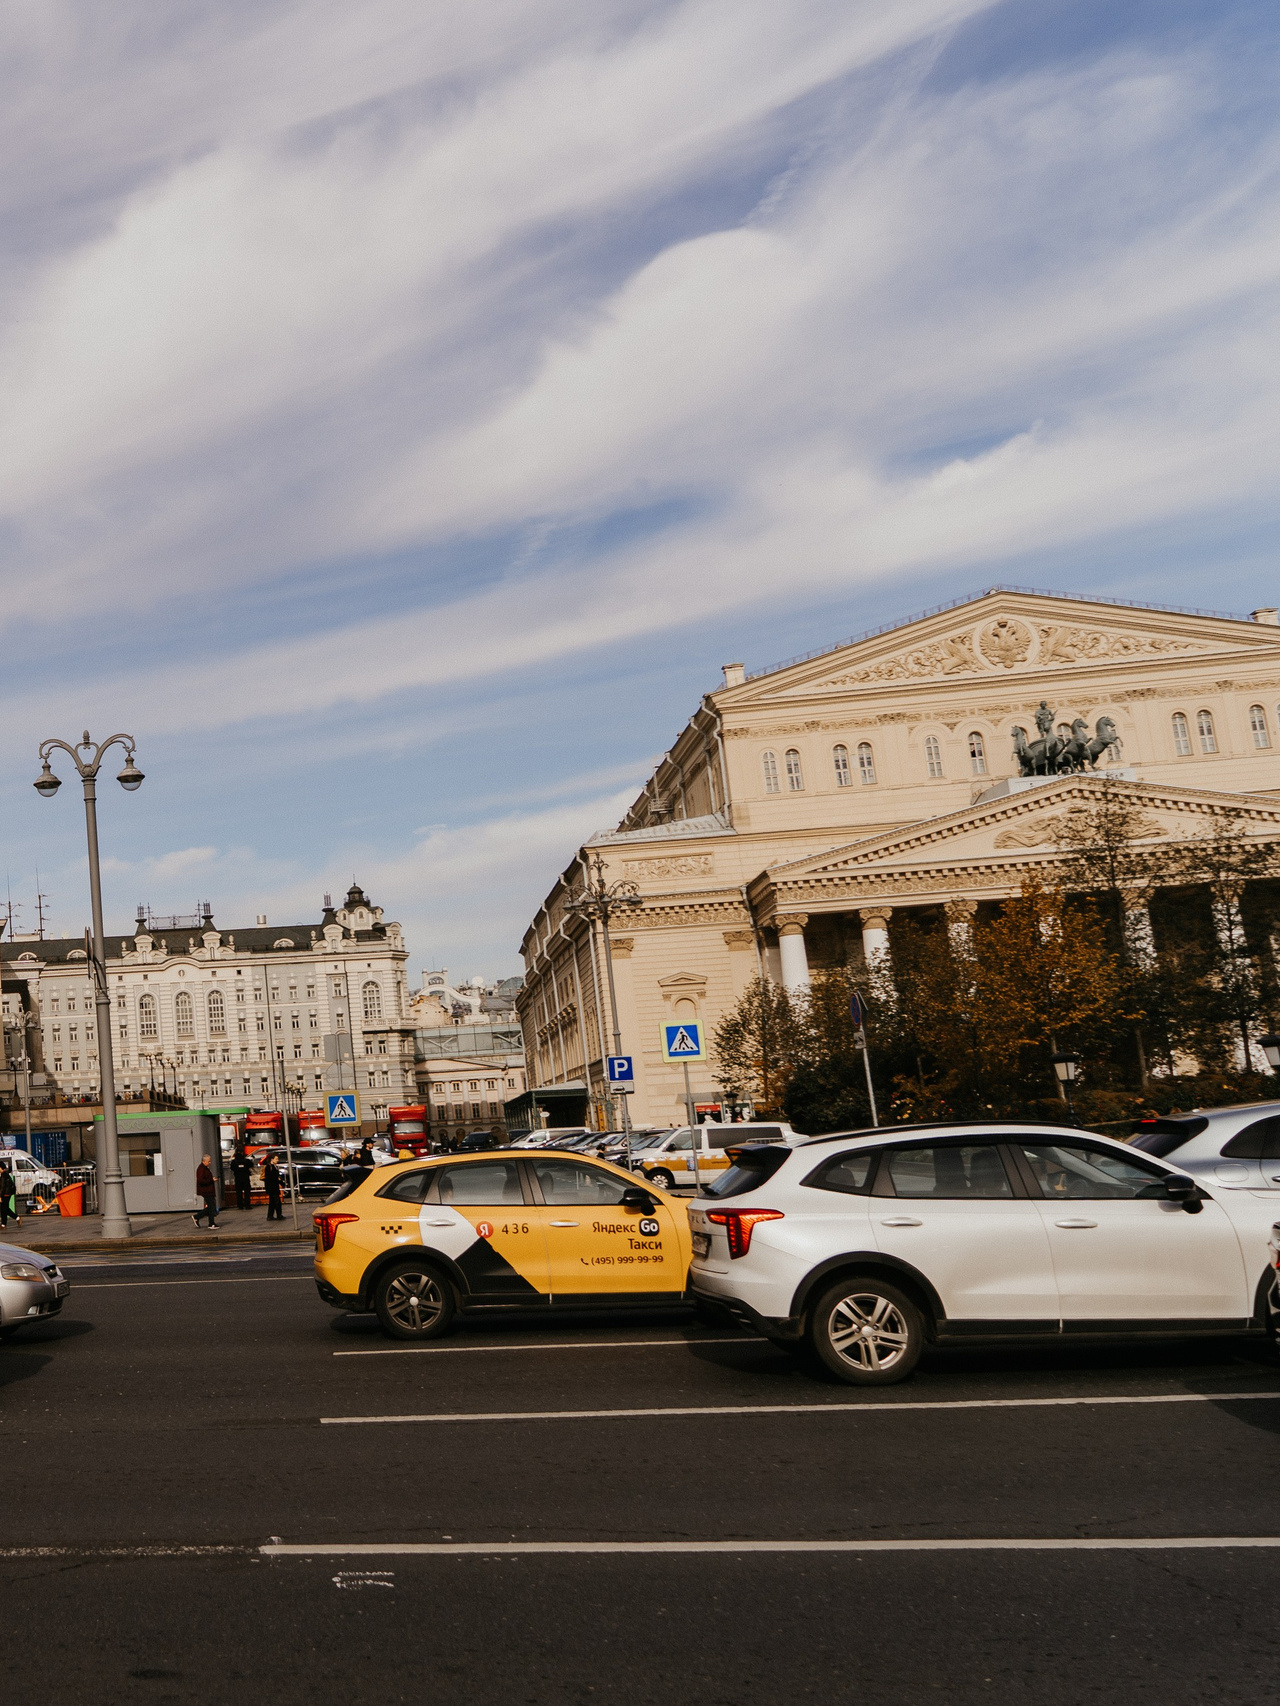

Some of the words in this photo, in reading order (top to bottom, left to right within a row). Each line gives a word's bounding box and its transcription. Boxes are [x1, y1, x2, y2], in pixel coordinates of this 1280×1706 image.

[613, 1059, 628, 1078] P
[479, 1224, 489, 1236] Я
[501, 1223, 529, 1235] 436
[592, 1222, 636, 1234] Яндекс
[640, 1219, 659, 1233] Go
[627, 1239, 662, 1250] Такси
[591, 1257, 615, 1266] (495)
[617, 1255, 664, 1265] 999-99-99
